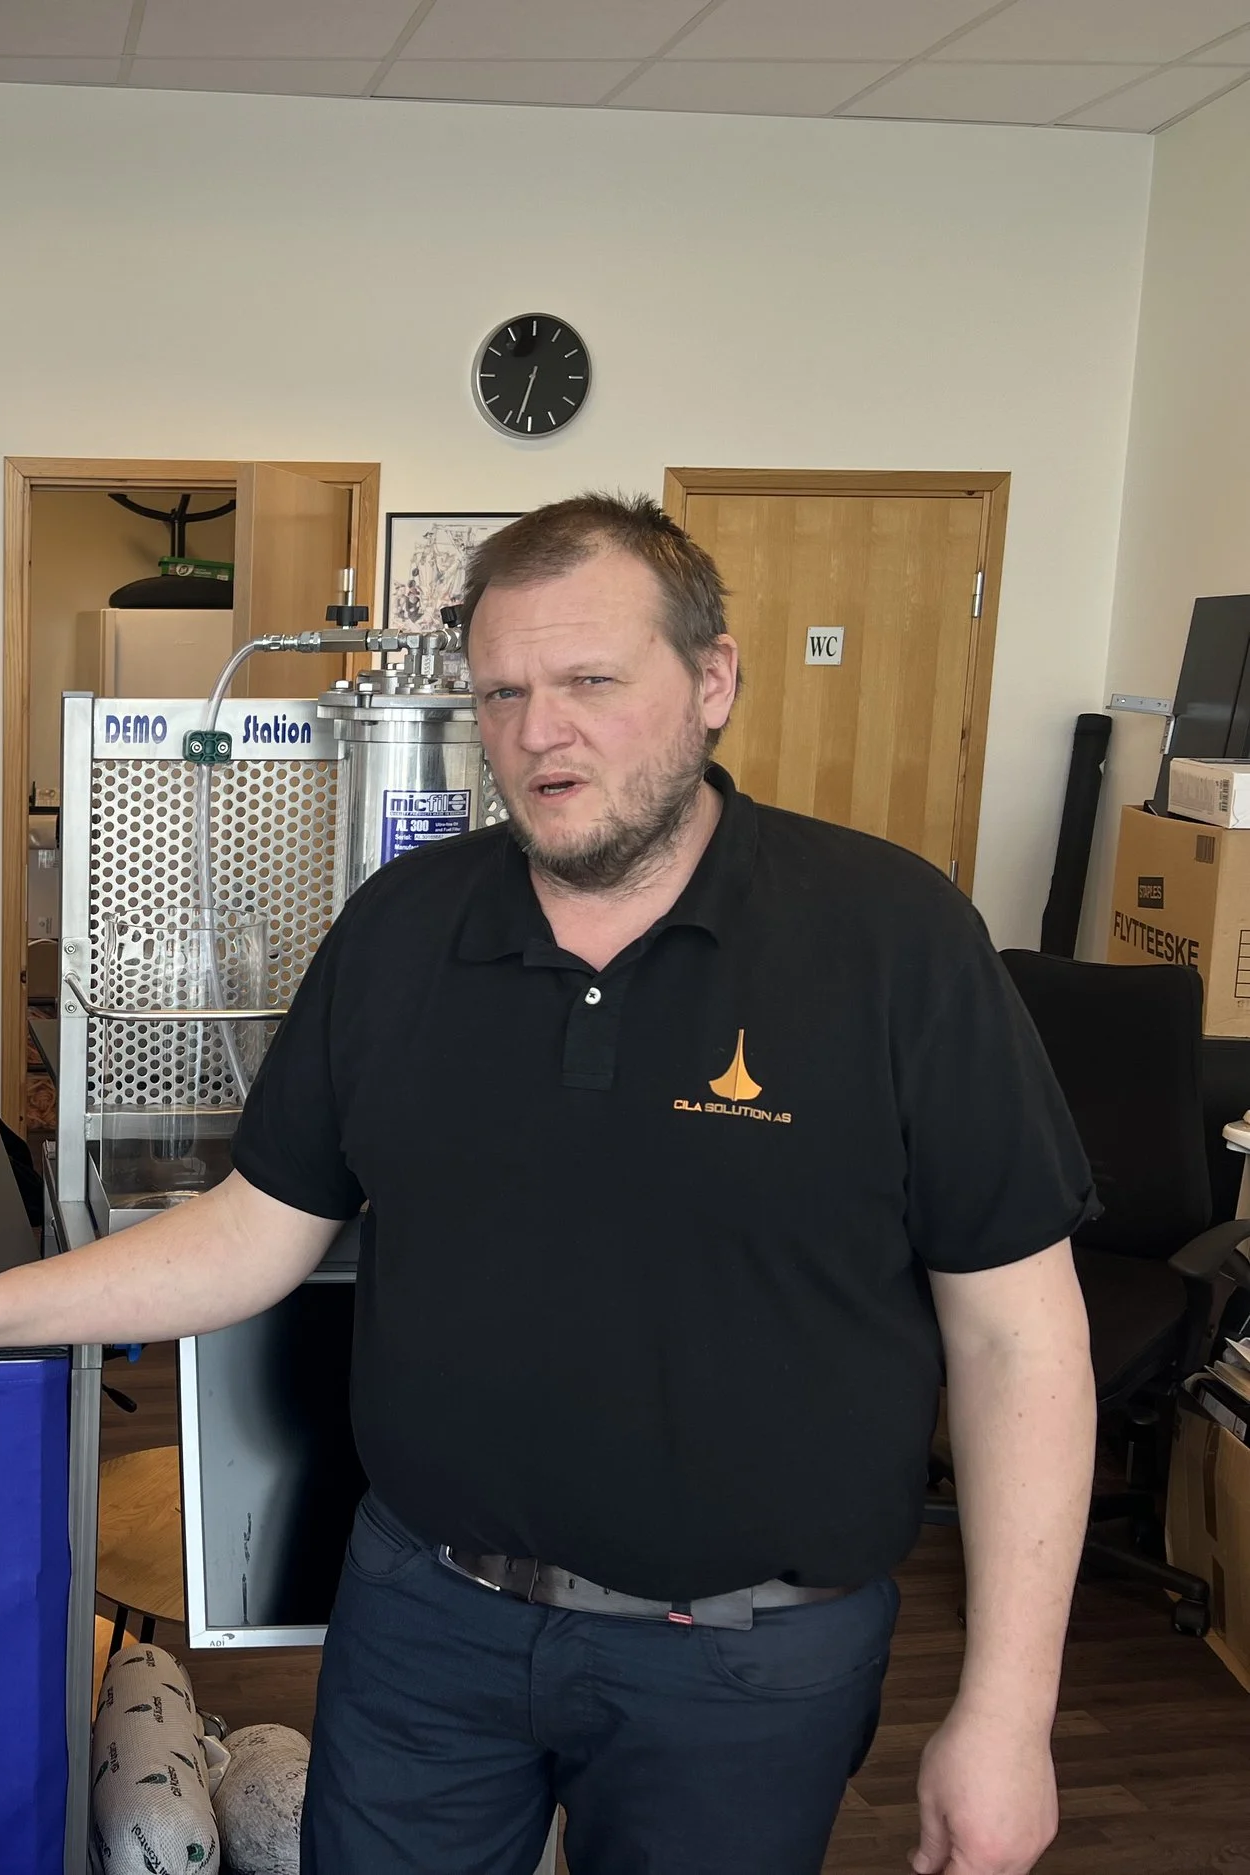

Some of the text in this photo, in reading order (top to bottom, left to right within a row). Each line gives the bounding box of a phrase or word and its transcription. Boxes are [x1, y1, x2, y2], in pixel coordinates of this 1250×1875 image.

[810, 636, 837, 657] WC
[105, 714, 312, 744] DEMO Station
[391, 794, 448, 812] micfil
[396, 819, 429, 832] AL 300
[1139, 885, 1162, 900] STAPLES
[1114, 911, 1200, 968] FLYTTEESKE
[673, 1100, 791, 1123] CILA SOLUTION AS
[131, 1823, 162, 1867] Kontrol
